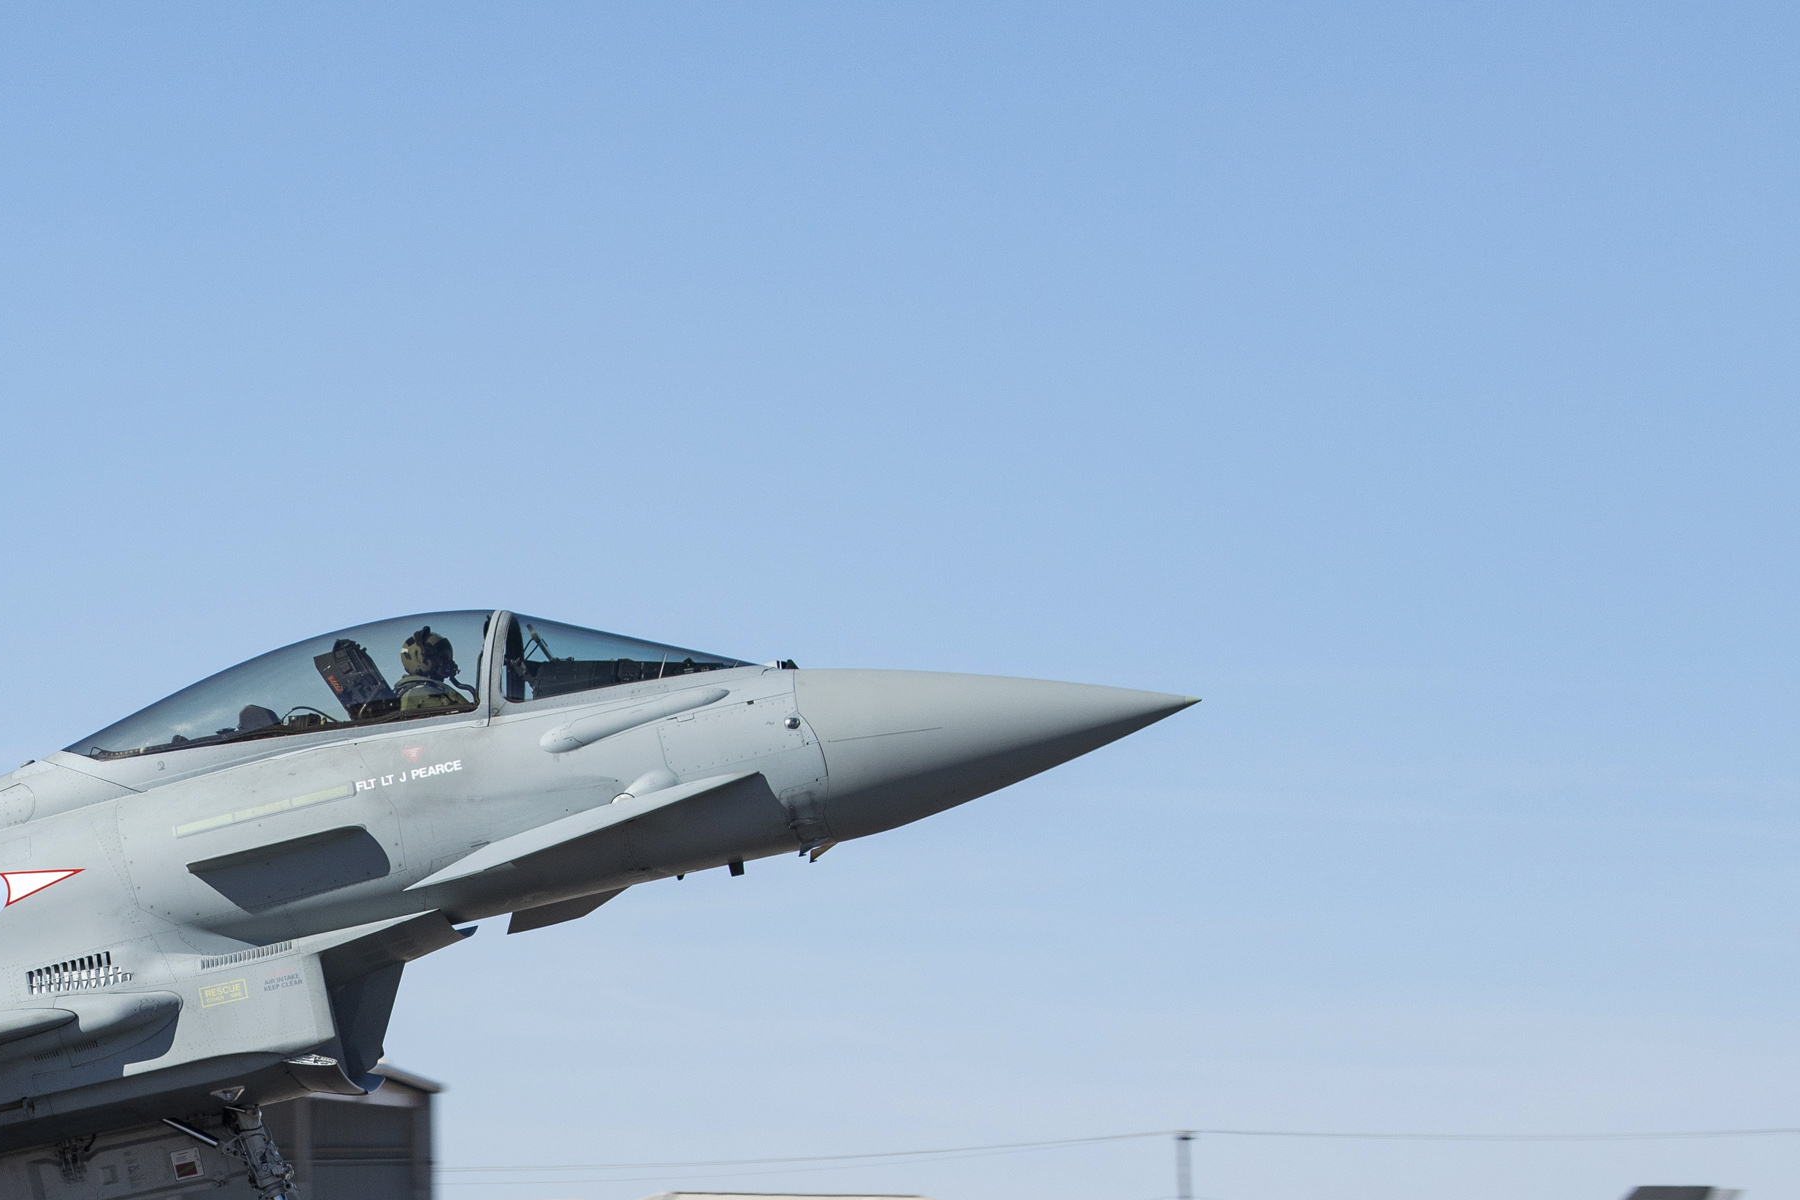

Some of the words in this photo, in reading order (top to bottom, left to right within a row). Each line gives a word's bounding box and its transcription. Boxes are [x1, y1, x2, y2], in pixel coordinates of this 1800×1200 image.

[355, 778, 376, 792] FLT
[380, 774, 395, 787] LT
[399, 771, 407, 783] J
[410, 759, 463, 780] PEARCE
[263, 983, 280, 992] KEEP
[281, 978, 303, 989] CLEAR
[264, 978, 276, 986] AIR
[276, 972, 300, 983] INTAKE
[204, 983, 242, 998] RESCUE
